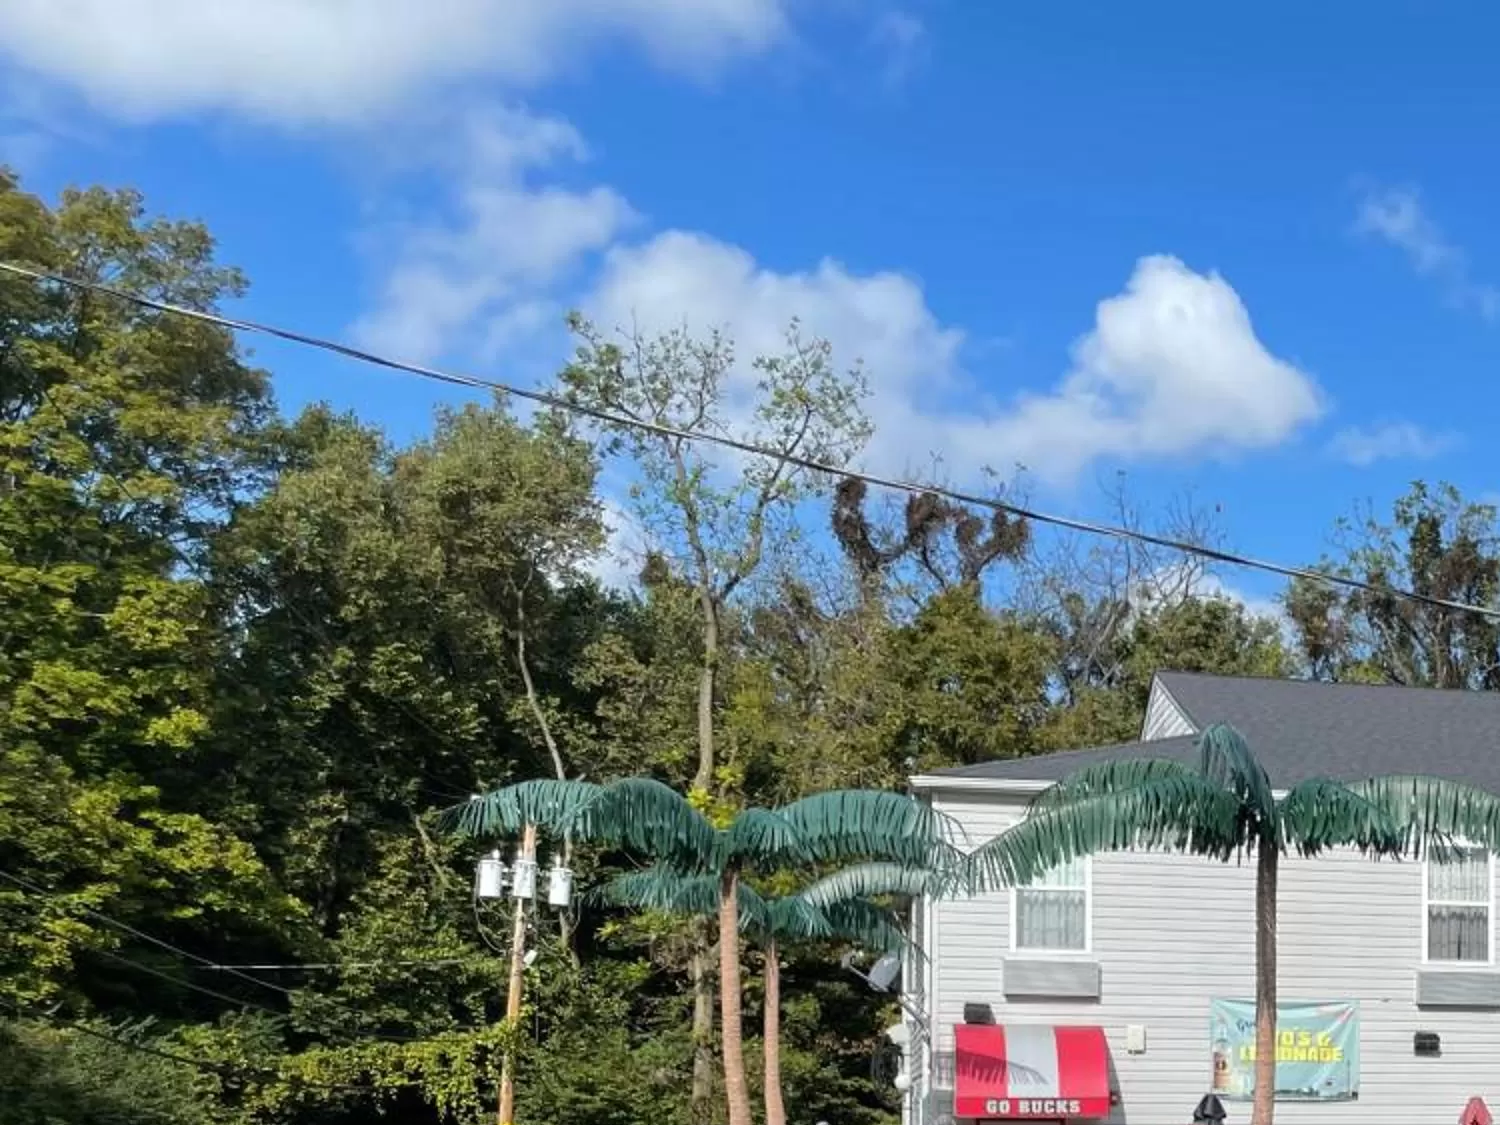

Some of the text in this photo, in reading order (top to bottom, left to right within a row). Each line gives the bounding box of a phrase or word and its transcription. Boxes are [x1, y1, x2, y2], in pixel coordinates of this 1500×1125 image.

[1239, 1044, 1345, 1062] LEONADE
[985, 1099, 1081, 1114] GO BUCKS
